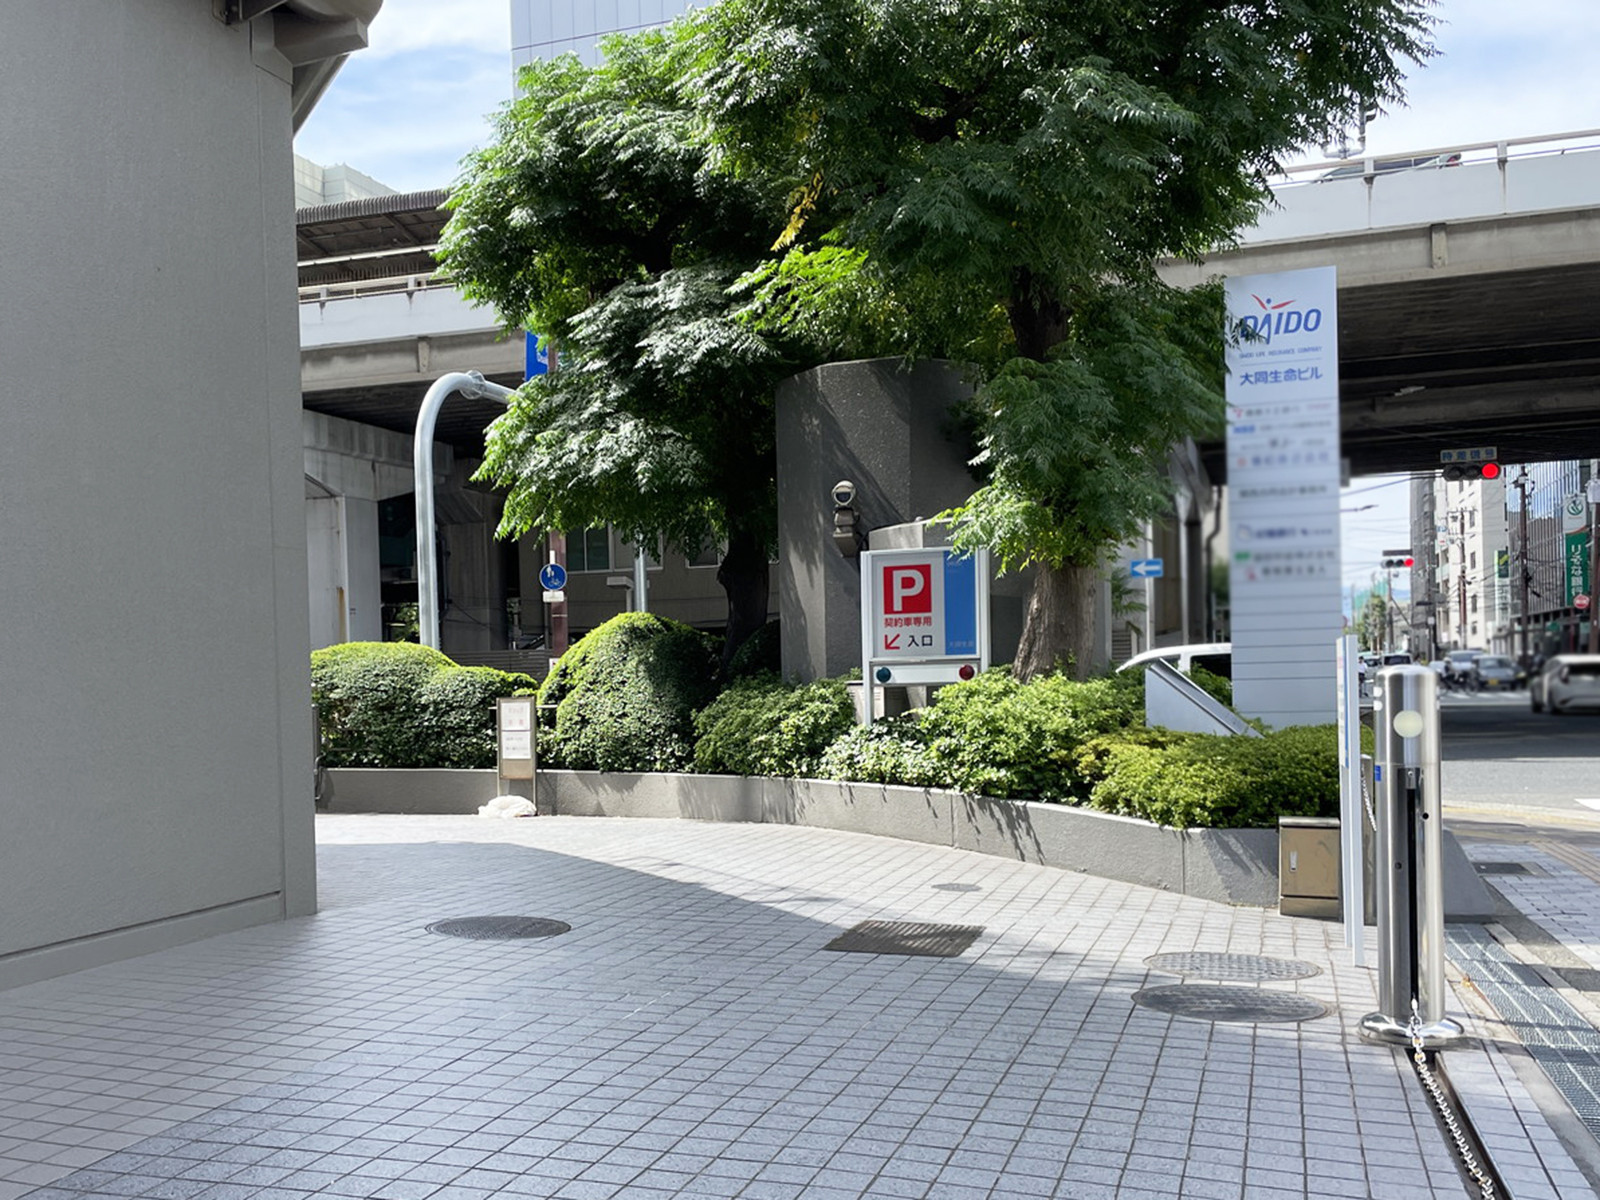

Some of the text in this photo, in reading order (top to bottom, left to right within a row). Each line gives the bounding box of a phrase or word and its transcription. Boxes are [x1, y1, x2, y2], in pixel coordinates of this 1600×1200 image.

[1240, 308, 1322, 345] DAIDO
[1240, 366, 1322, 386] 大同生命ビル
[892, 569, 925, 612] P
[884, 616, 932, 628] 契約車専用
[907, 635, 933, 647] 入口
